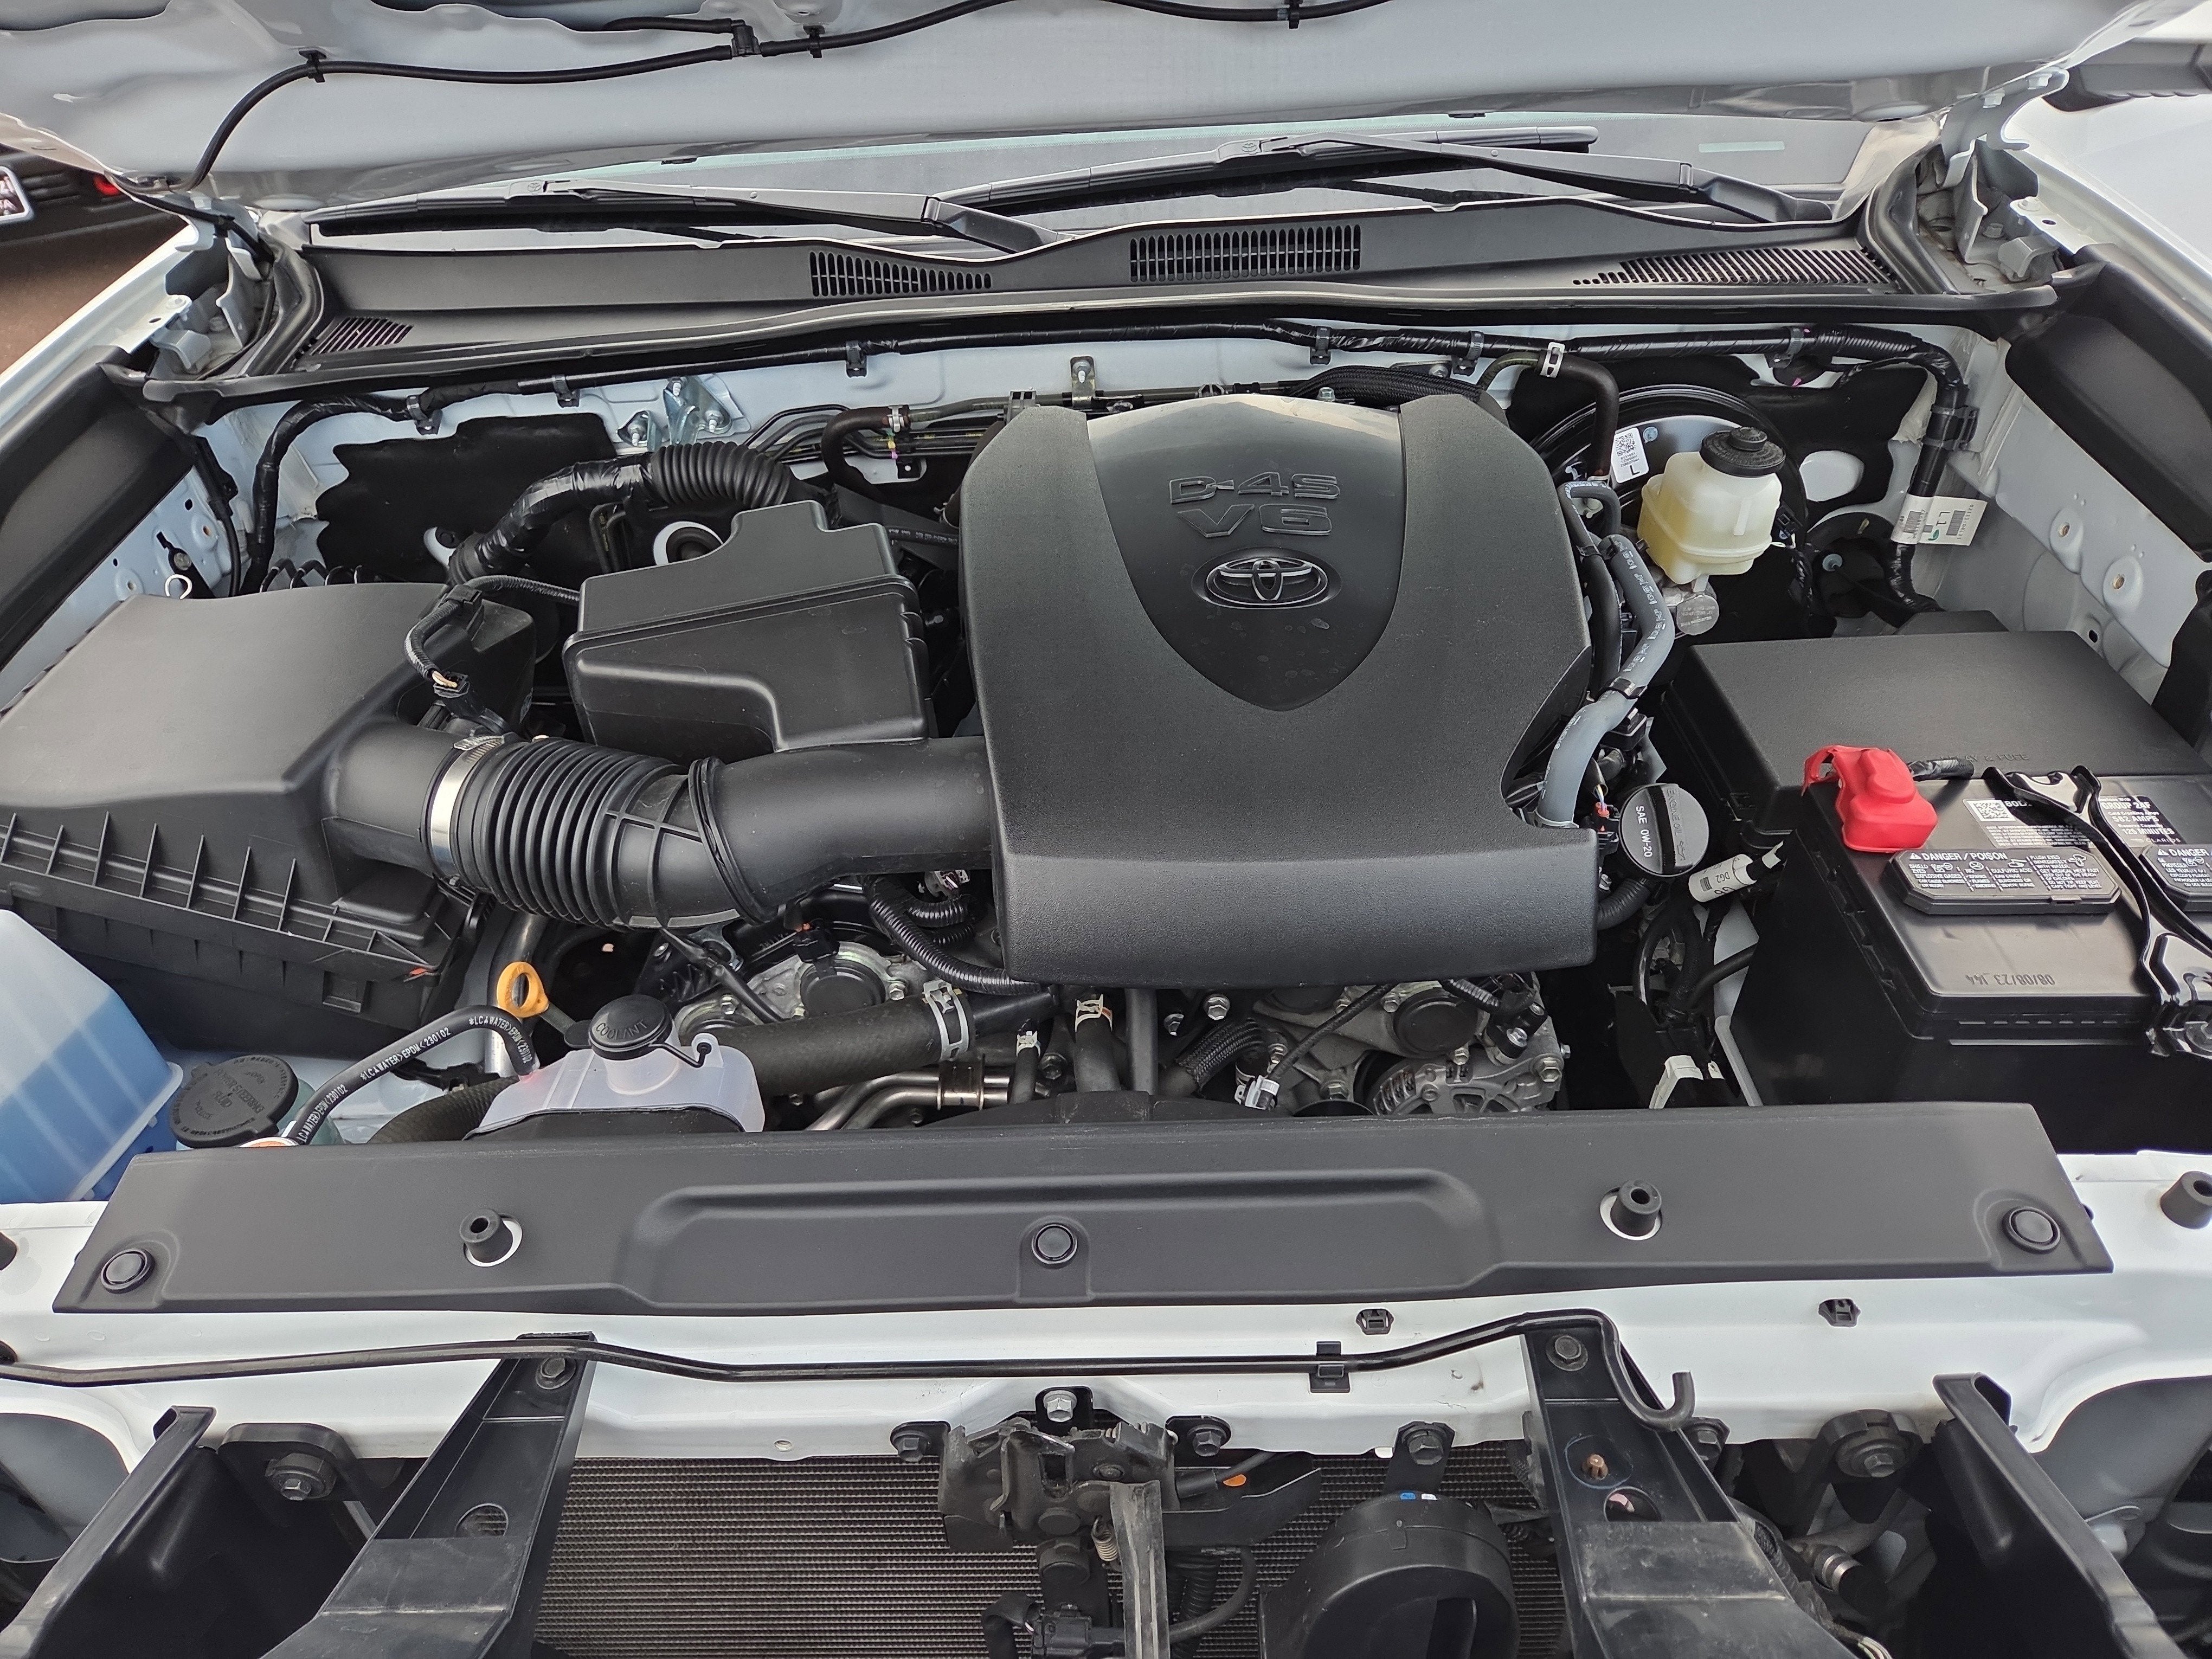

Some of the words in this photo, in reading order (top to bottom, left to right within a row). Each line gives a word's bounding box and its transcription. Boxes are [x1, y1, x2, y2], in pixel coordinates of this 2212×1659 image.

[1169, 471, 1340, 504] D-4S
[1177, 503, 1332, 538] V6
[1636, 806, 1648, 824] SAE
[1666, 788, 1681, 822] ENGINE
[1673, 822, 1683, 837] OIL
[1639, 829, 1653, 858] 0W-20
[1969, 852, 2008, 860] POISON
[1993, 974, 2056, 986] 08/08/23
[596, 1019, 647, 1040] COOLANT
